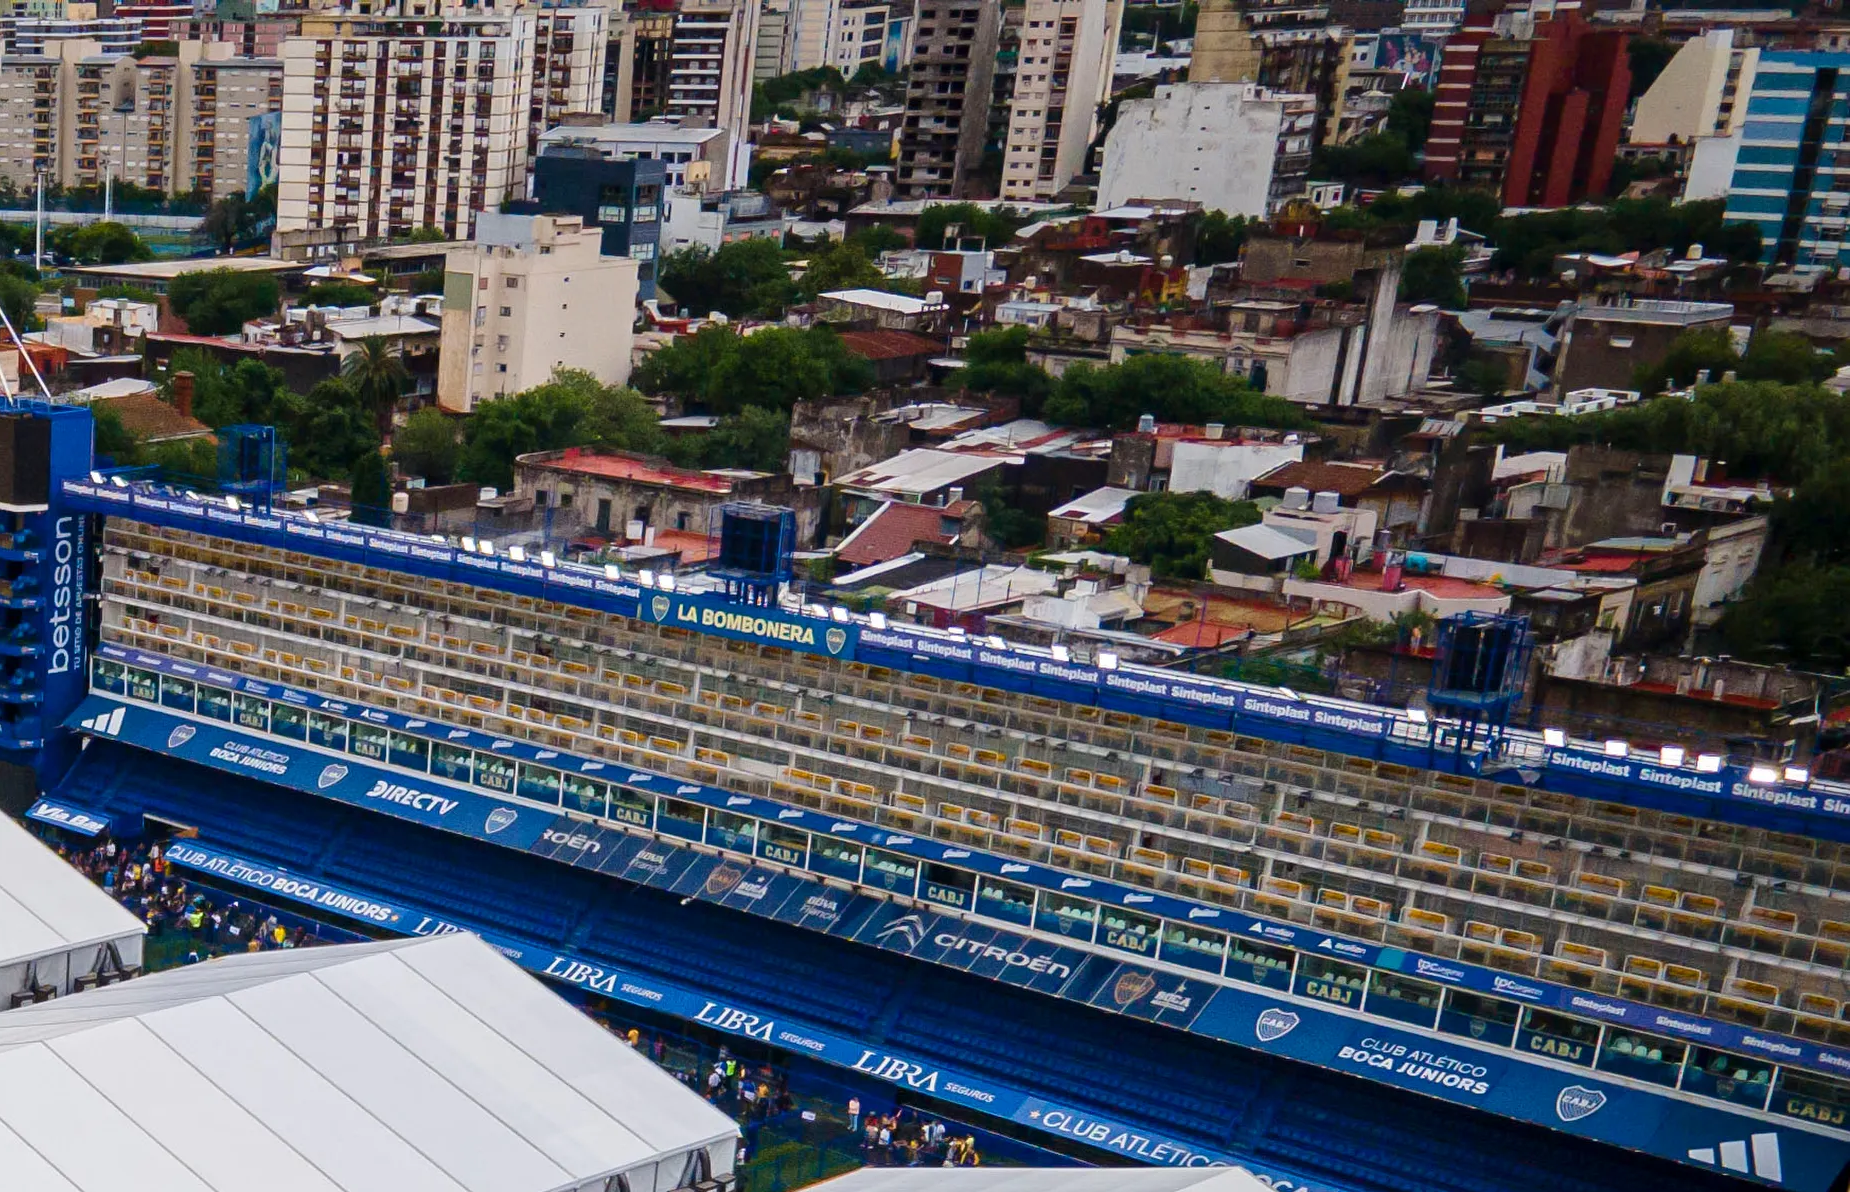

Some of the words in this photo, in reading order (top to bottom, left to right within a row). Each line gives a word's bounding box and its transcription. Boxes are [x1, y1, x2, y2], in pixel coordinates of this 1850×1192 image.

[48, 516, 73, 676] betsson
[75, 609, 83, 625] DE
[677, 603, 698, 624] LA
[702, 608, 815, 646] BOMBONERA
[73, 656, 81, 671] TU
[860, 630, 914, 650] Sinteplast
[917, 640, 973, 660] Sinteplast
[980, 651, 1037, 671] Sinteplast
[1039, 662, 1099, 683] Sinteplast
[1106, 674, 1167, 697] Sinteplast
[1171, 685, 1235, 707] Sinteplast
[1244, 698, 1310, 721] Sinteplast
[1314, 710, 1383, 733] Sinteplast
[223, 741, 249, 753] CLUB
[210, 748, 242, 764] BOCA
[242, 755, 288, 776] JUNIORS
[1551, 751, 1631, 778] Sinteplast
[1639, 768, 1722, 794] Sinteplast
[1732, 783, 1817, 809] Sinteplast
[36, 804, 71, 820] Via
[365, 780, 460, 816] DIRECTV
[616, 807, 648, 826] CABJ
[165, 845, 207, 866] CLUB
[765, 844, 799, 864] CABJ
[271, 877, 318, 900] BOCA
[317, 891, 393, 922] JUNIORS
[927, 886, 965, 907] CABJ
[934, 933, 1071, 978] CITROËN
[542, 956, 619, 993] LIBRA
[621, 983, 664, 1001] SEGUROS
[1306, 981, 1352, 1004] CABJ
[693, 1002, 776, 1041] LIBRA
[778, 1031, 826, 1051] SEGUROS
[1261, 1016, 1292, 1030] CABJ
[1360, 1037, 1407, 1057] CLUB
[1407, 1050, 1488, 1078] ATLÉTICO
[1530, 1036, 1583, 1060] CABJ
[852, 1051, 939, 1091] LIBRA
[944, 1082, 996, 1103] SEGUROS
[1338, 1046, 1394, 1070] BOCA
[1396, 1063, 1491, 1095] JUNIORS
[1561, 1095, 1599, 1109] CABJ
[1786, 1098, 1846, 1125] CABJ
[1043, 1111, 1112, 1142] CLUB
